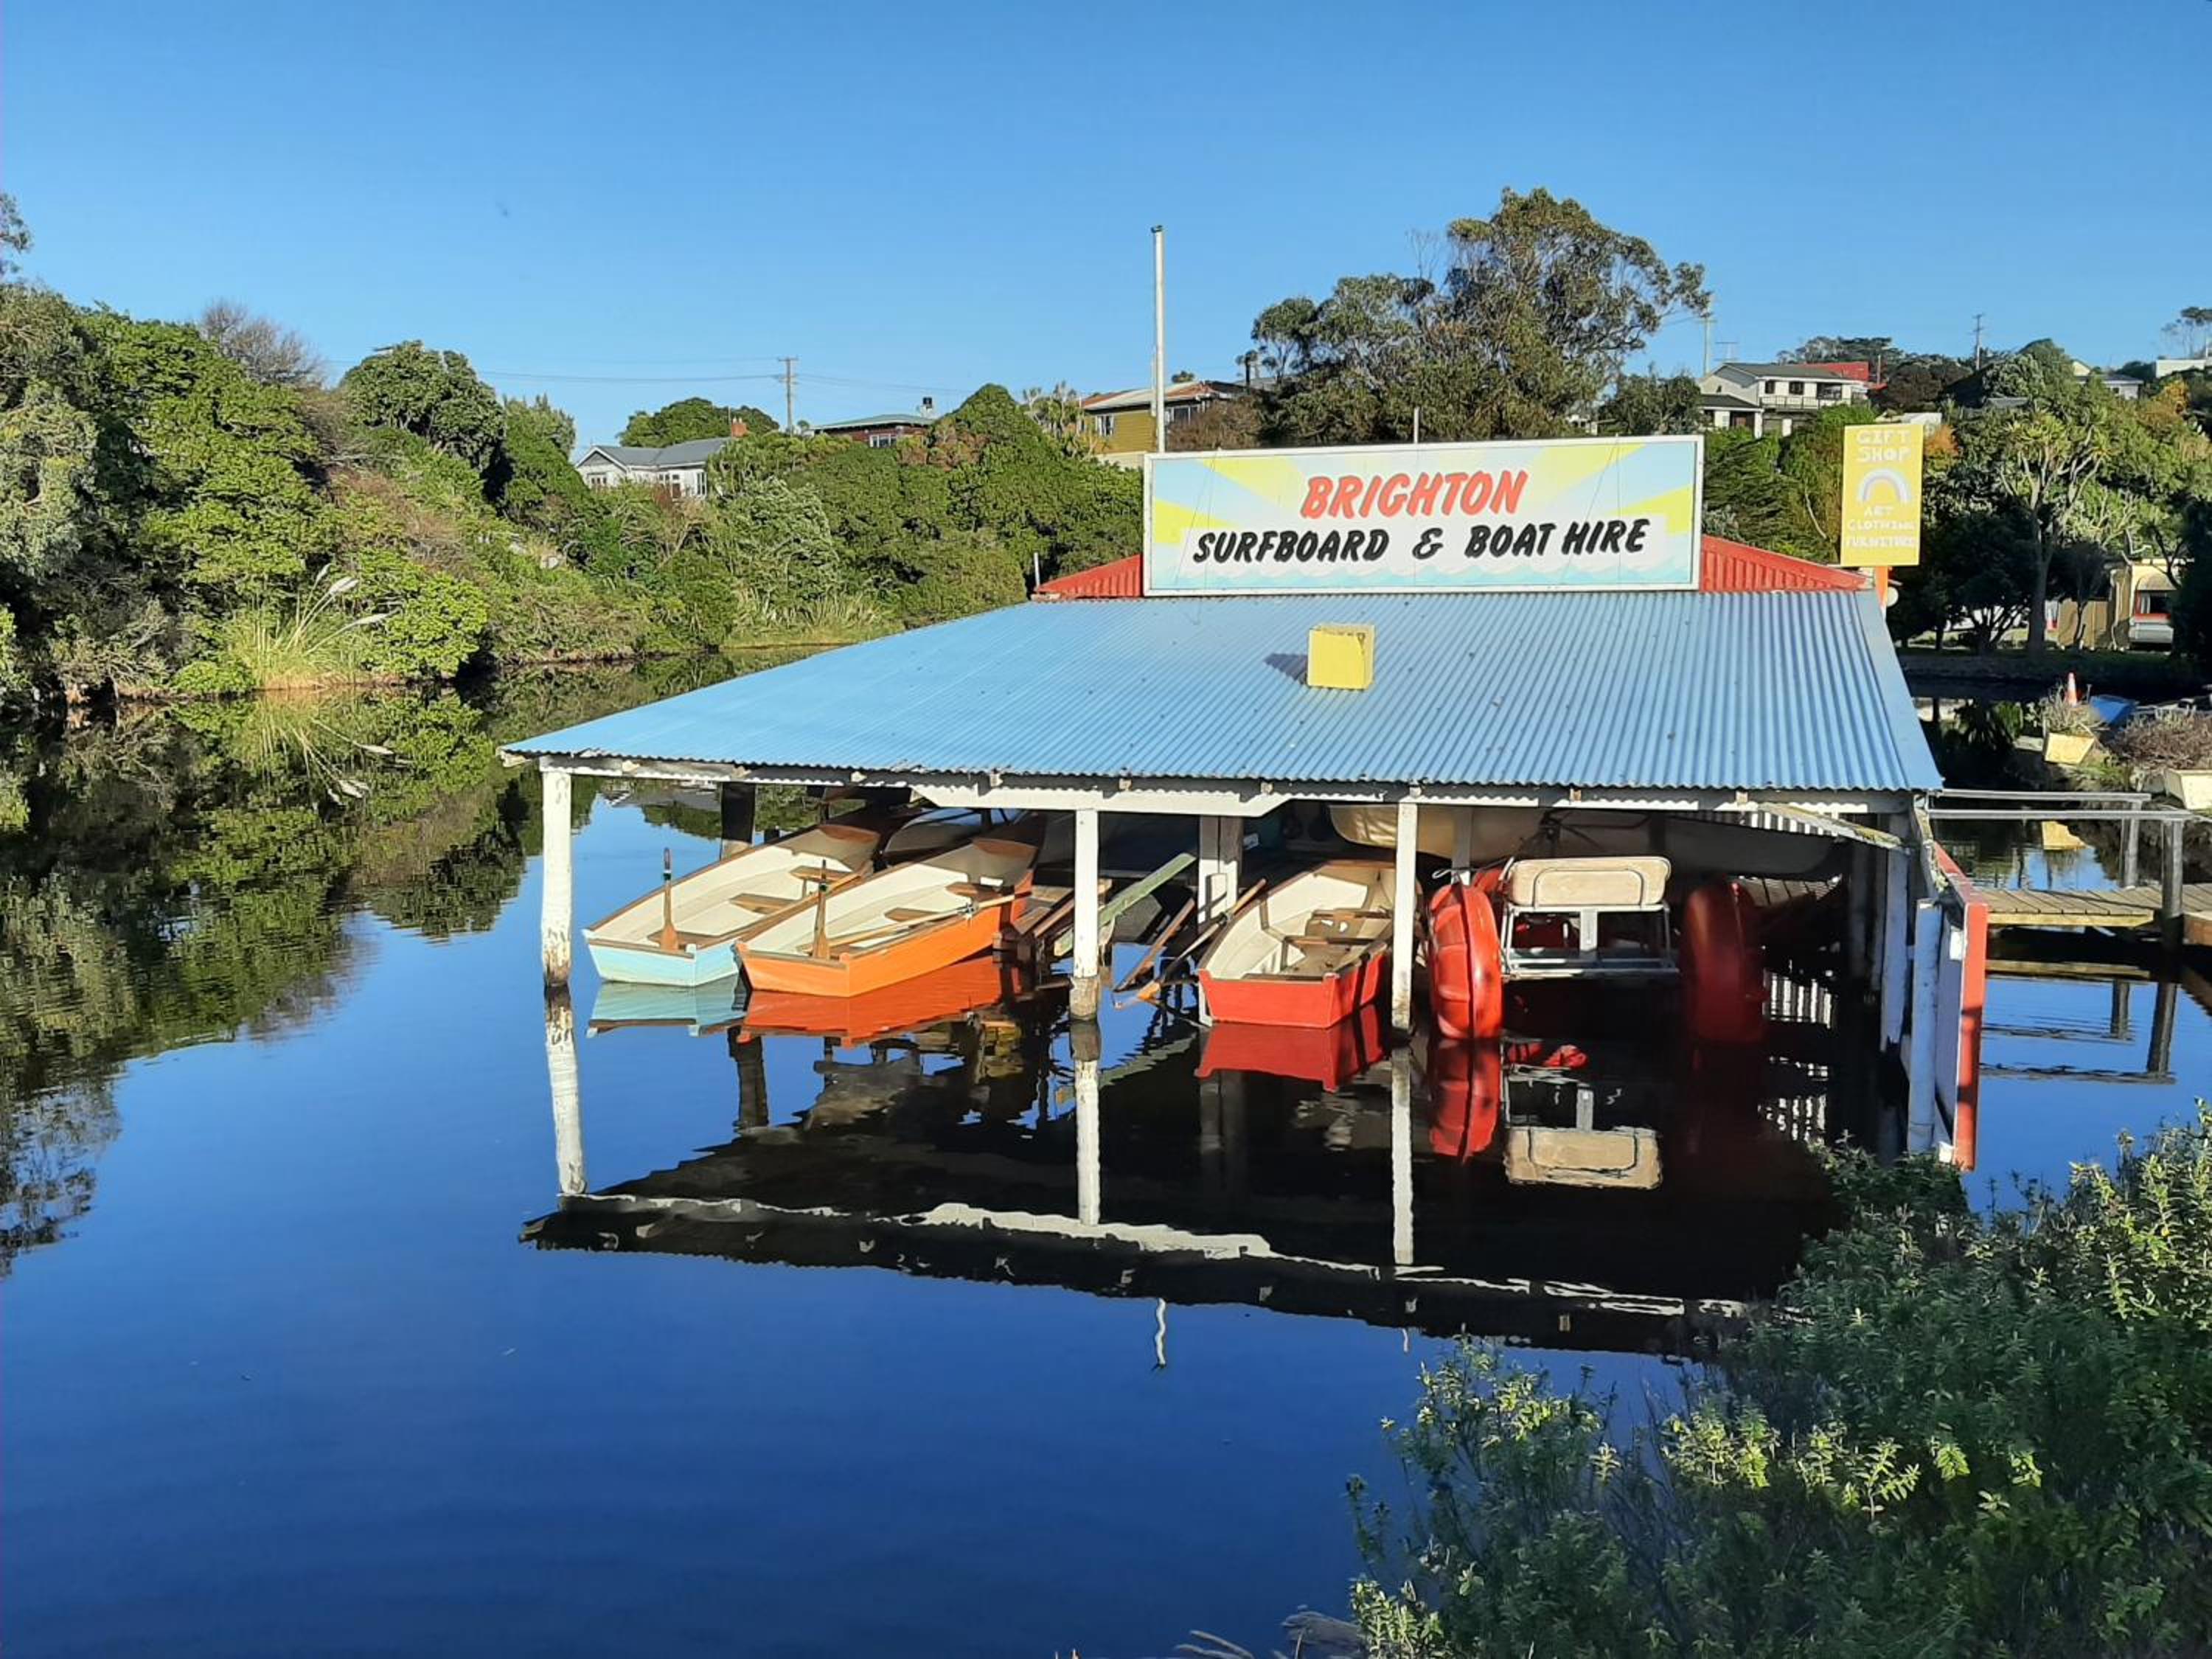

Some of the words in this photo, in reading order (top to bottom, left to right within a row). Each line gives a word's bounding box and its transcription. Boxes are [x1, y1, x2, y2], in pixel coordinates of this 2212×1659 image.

[1856, 429, 1910, 445] GIFT
[1857, 447, 1910, 462] SHOP
[1300, 470, 1528, 518] BRIGHTON
[1864, 506, 1894, 518] ART
[1193, 529, 1390, 563] SURFBOARD
[1413, 527, 1443, 559] &
[1465, 523, 1555, 558] BOAT
[1562, 518, 1650, 555] HIRE
